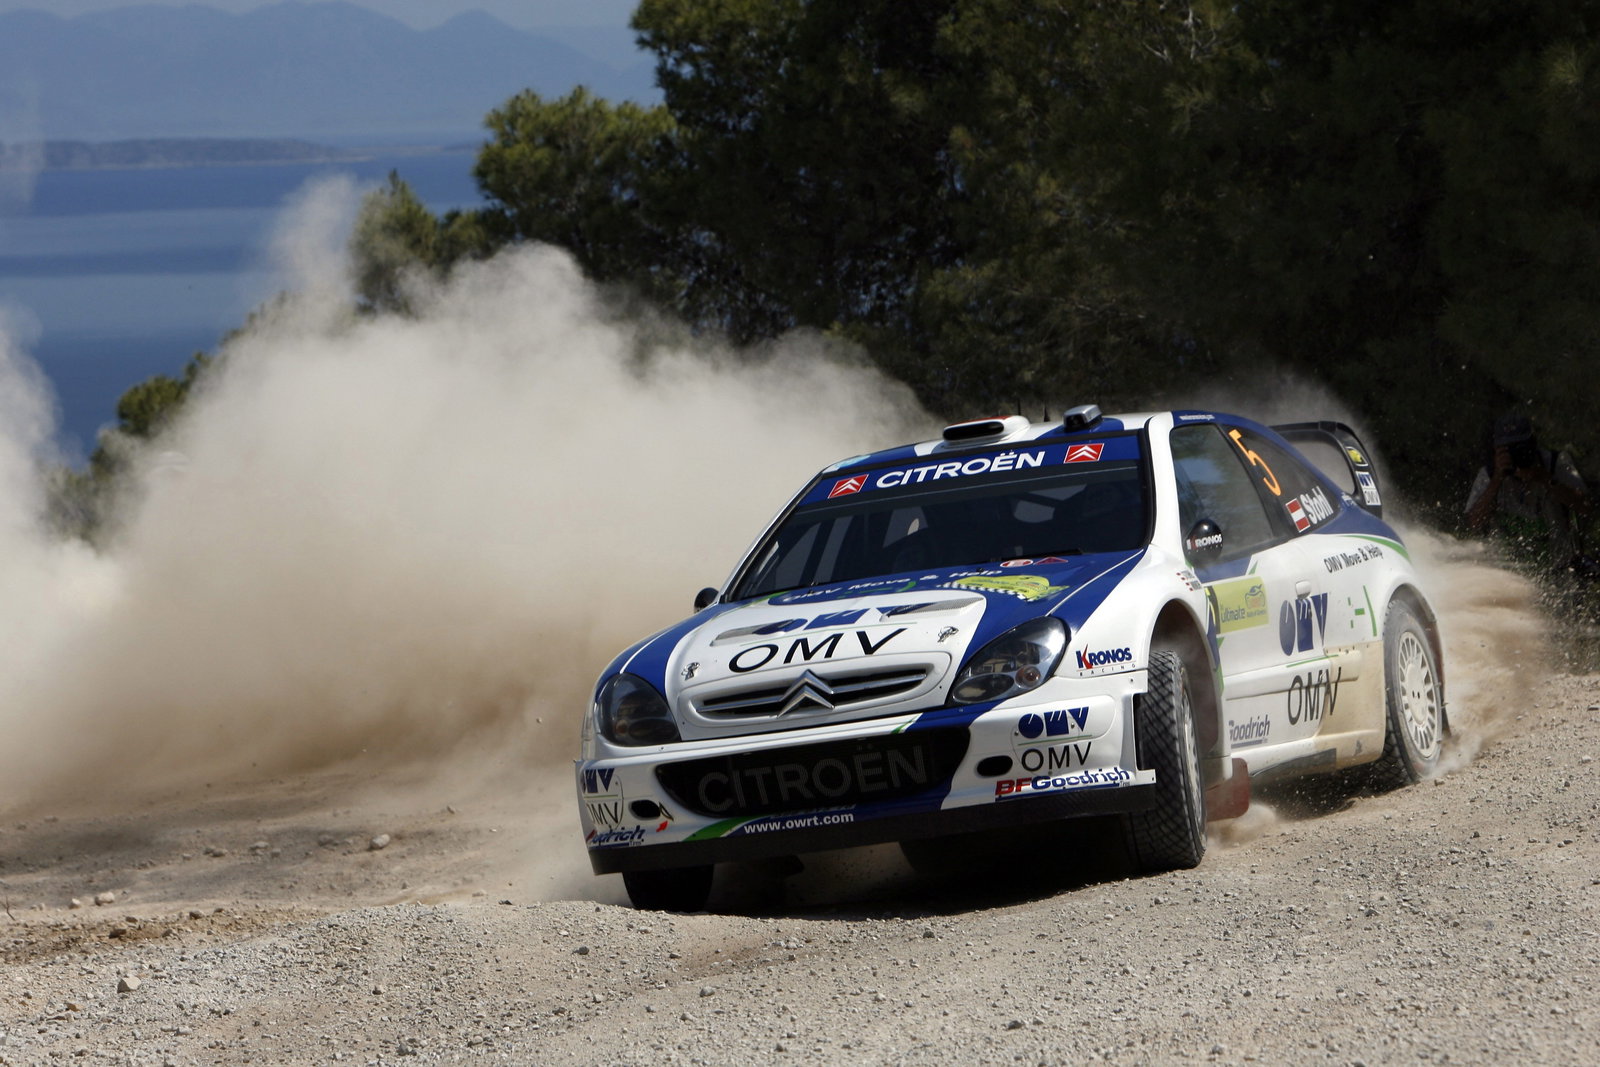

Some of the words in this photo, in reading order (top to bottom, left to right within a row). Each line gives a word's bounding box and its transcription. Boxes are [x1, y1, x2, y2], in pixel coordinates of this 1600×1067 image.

[876, 450, 1046, 489] CITROËN
[1228, 429, 1282, 497] 5
[1300, 485, 1334, 525] Stohl
[1186, 533, 1223, 550] KRONOS
[1323, 554, 1343, 573] OMV
[1340, 552, 1362, 568] Move
[1357, 547, 1370, 561] &
[1364, 543, 1384, 560] Help
[847, 578, 911, 590] Move
[949, 569, 1003, 578] Help
[728, 627, 909, 674] OMV
[1075, 643, 1133, 670] KRONOS
[1079, 663, 1136, 677] RACING
[1286, 666, 1343, 726] OMV
[1021, 741, 1093, 773] OMV
[698, 744, 928, 813] CITROËN
[995, 767, 1130, 797] BFGoodrich
[743, 812, 855, 834] www.owrt.com
